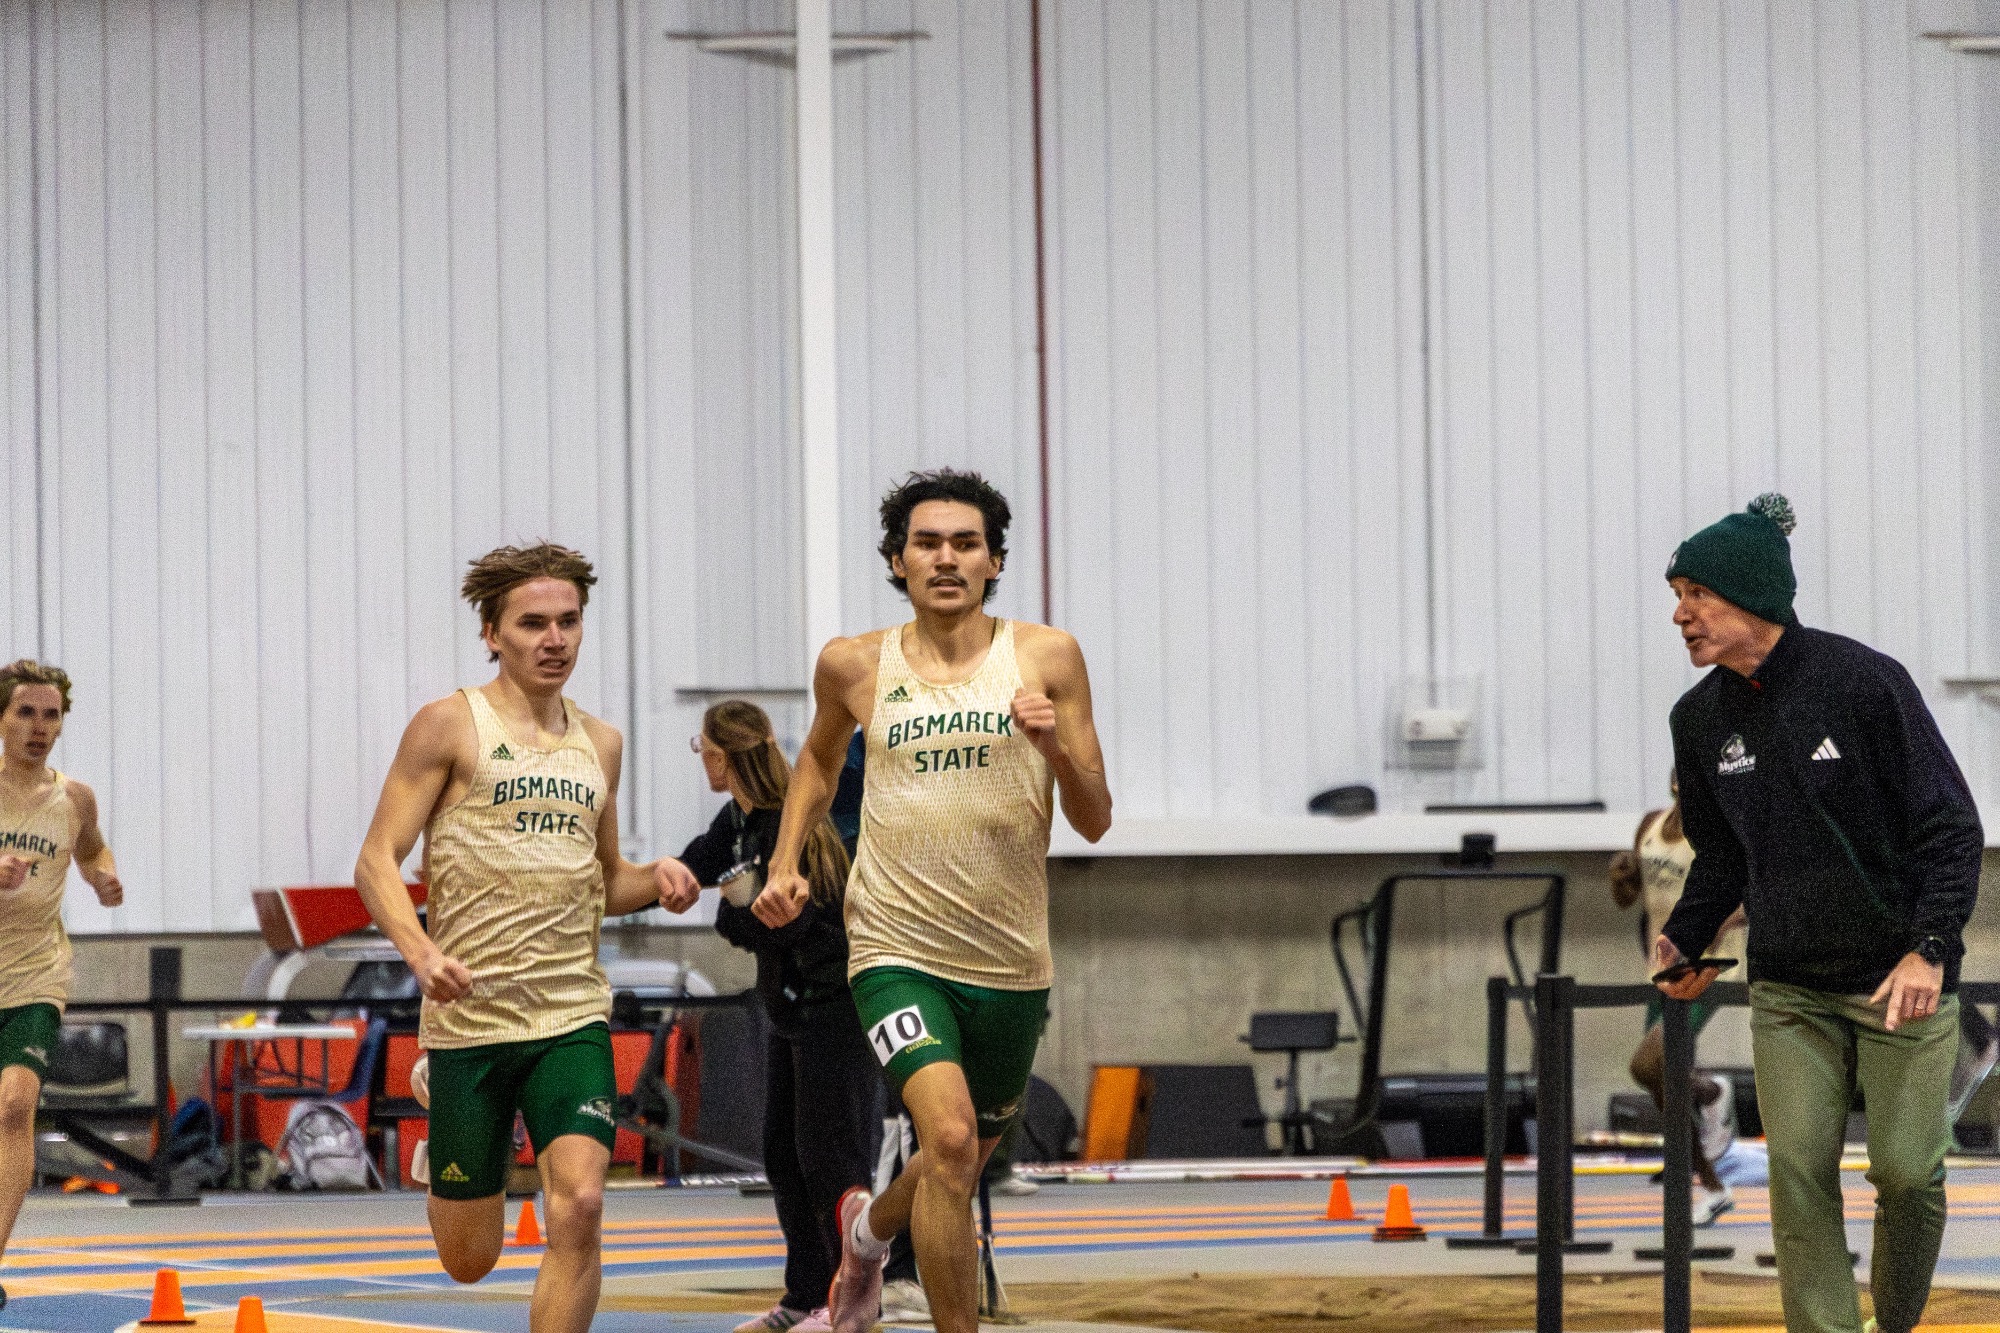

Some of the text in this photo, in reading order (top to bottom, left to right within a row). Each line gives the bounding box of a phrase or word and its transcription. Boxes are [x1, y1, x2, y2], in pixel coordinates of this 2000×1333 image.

[887, 711, 1012, 750] BISMARCK
[914, 744, 990, 773] STATE
[492, 776, 596, 811] BISMARCK
[514, 811, 580, 835] STATE
[874, 1011, 923, 1055] 10
